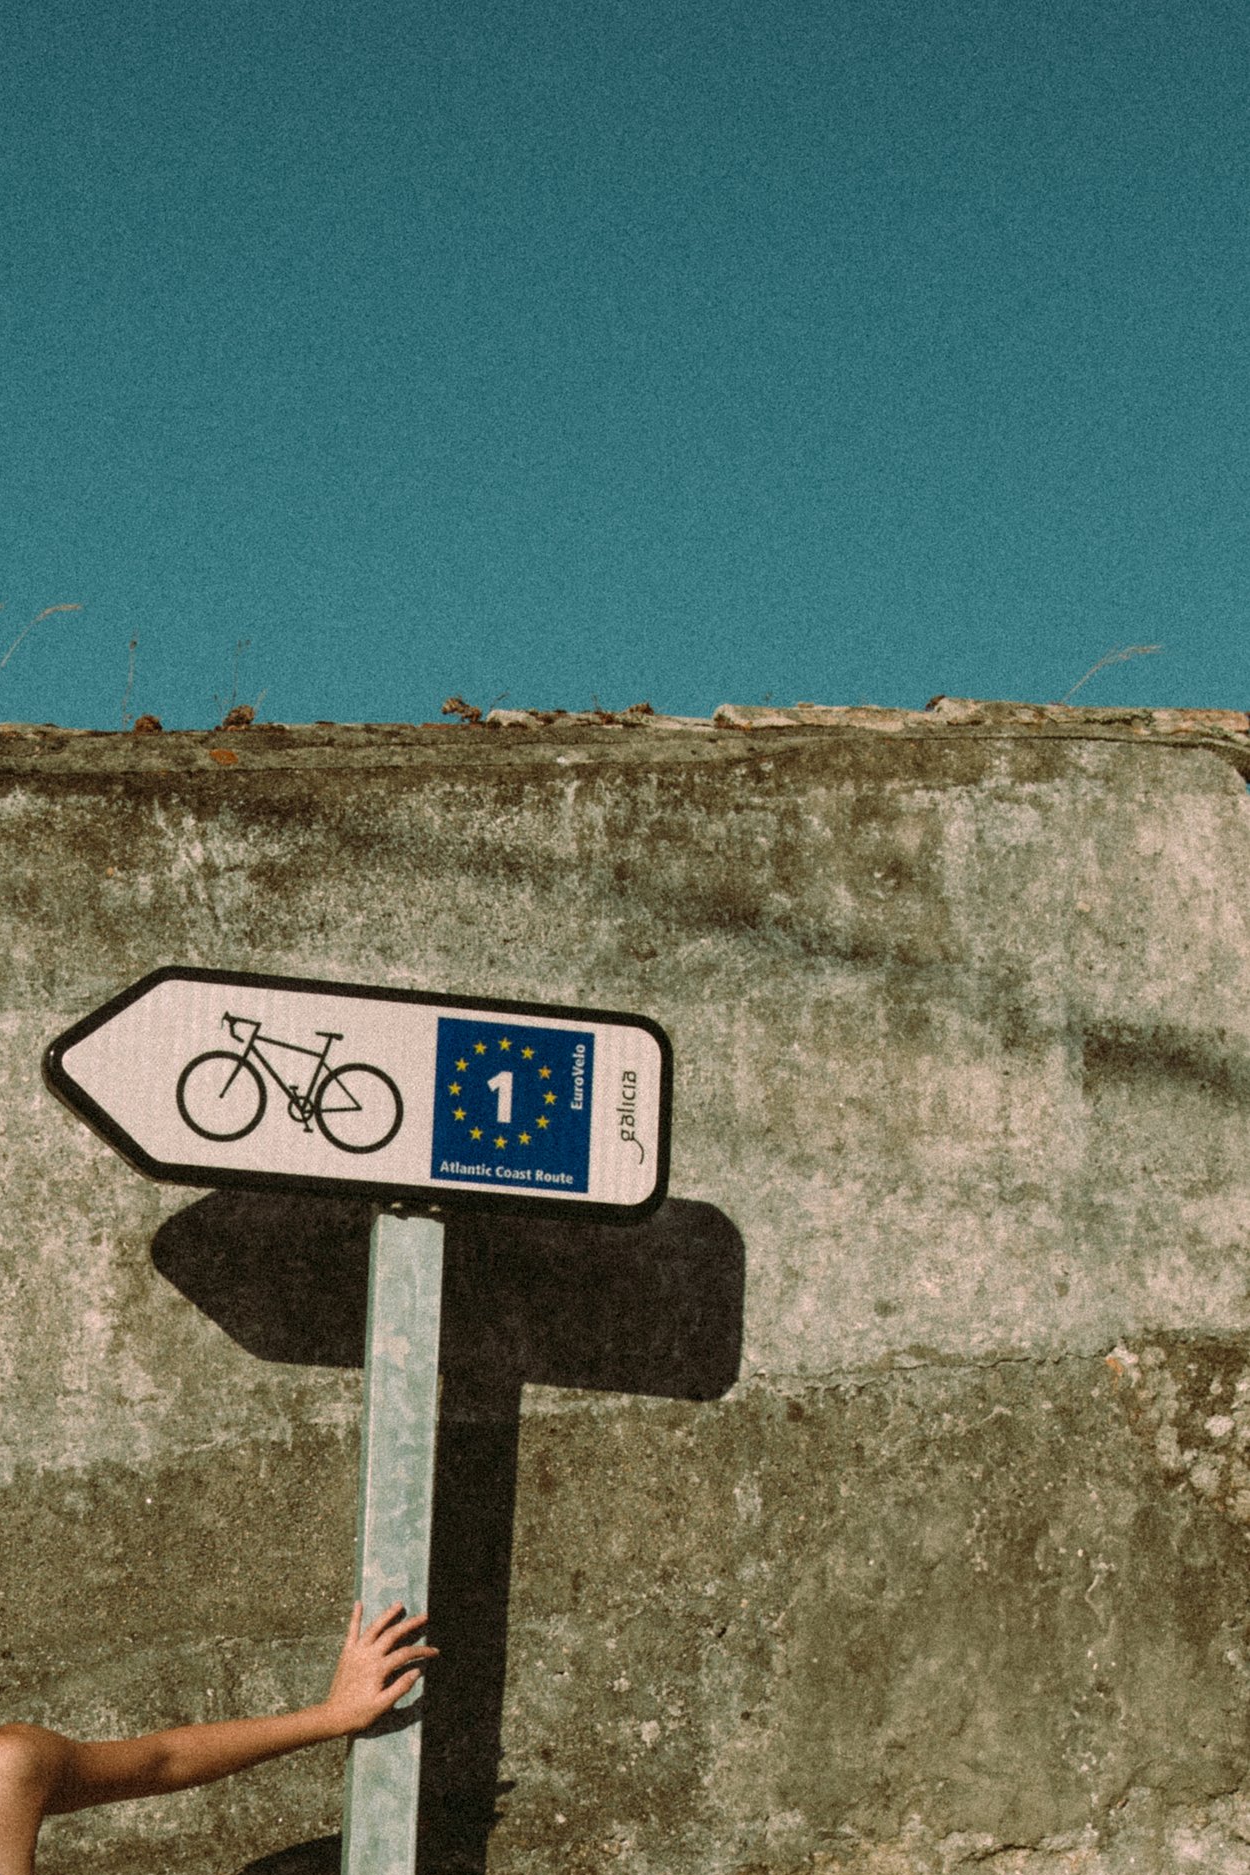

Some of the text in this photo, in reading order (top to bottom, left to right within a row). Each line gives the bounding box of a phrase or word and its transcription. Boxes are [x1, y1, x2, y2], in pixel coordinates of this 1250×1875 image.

[487, 1071, 513, 1123] 1
[571, 1043, 586, 1110] EuroVelo
[616, 1070, 644, 1164] galicia
[440, 1160, 574, 1185] Atlantic Coast Route
